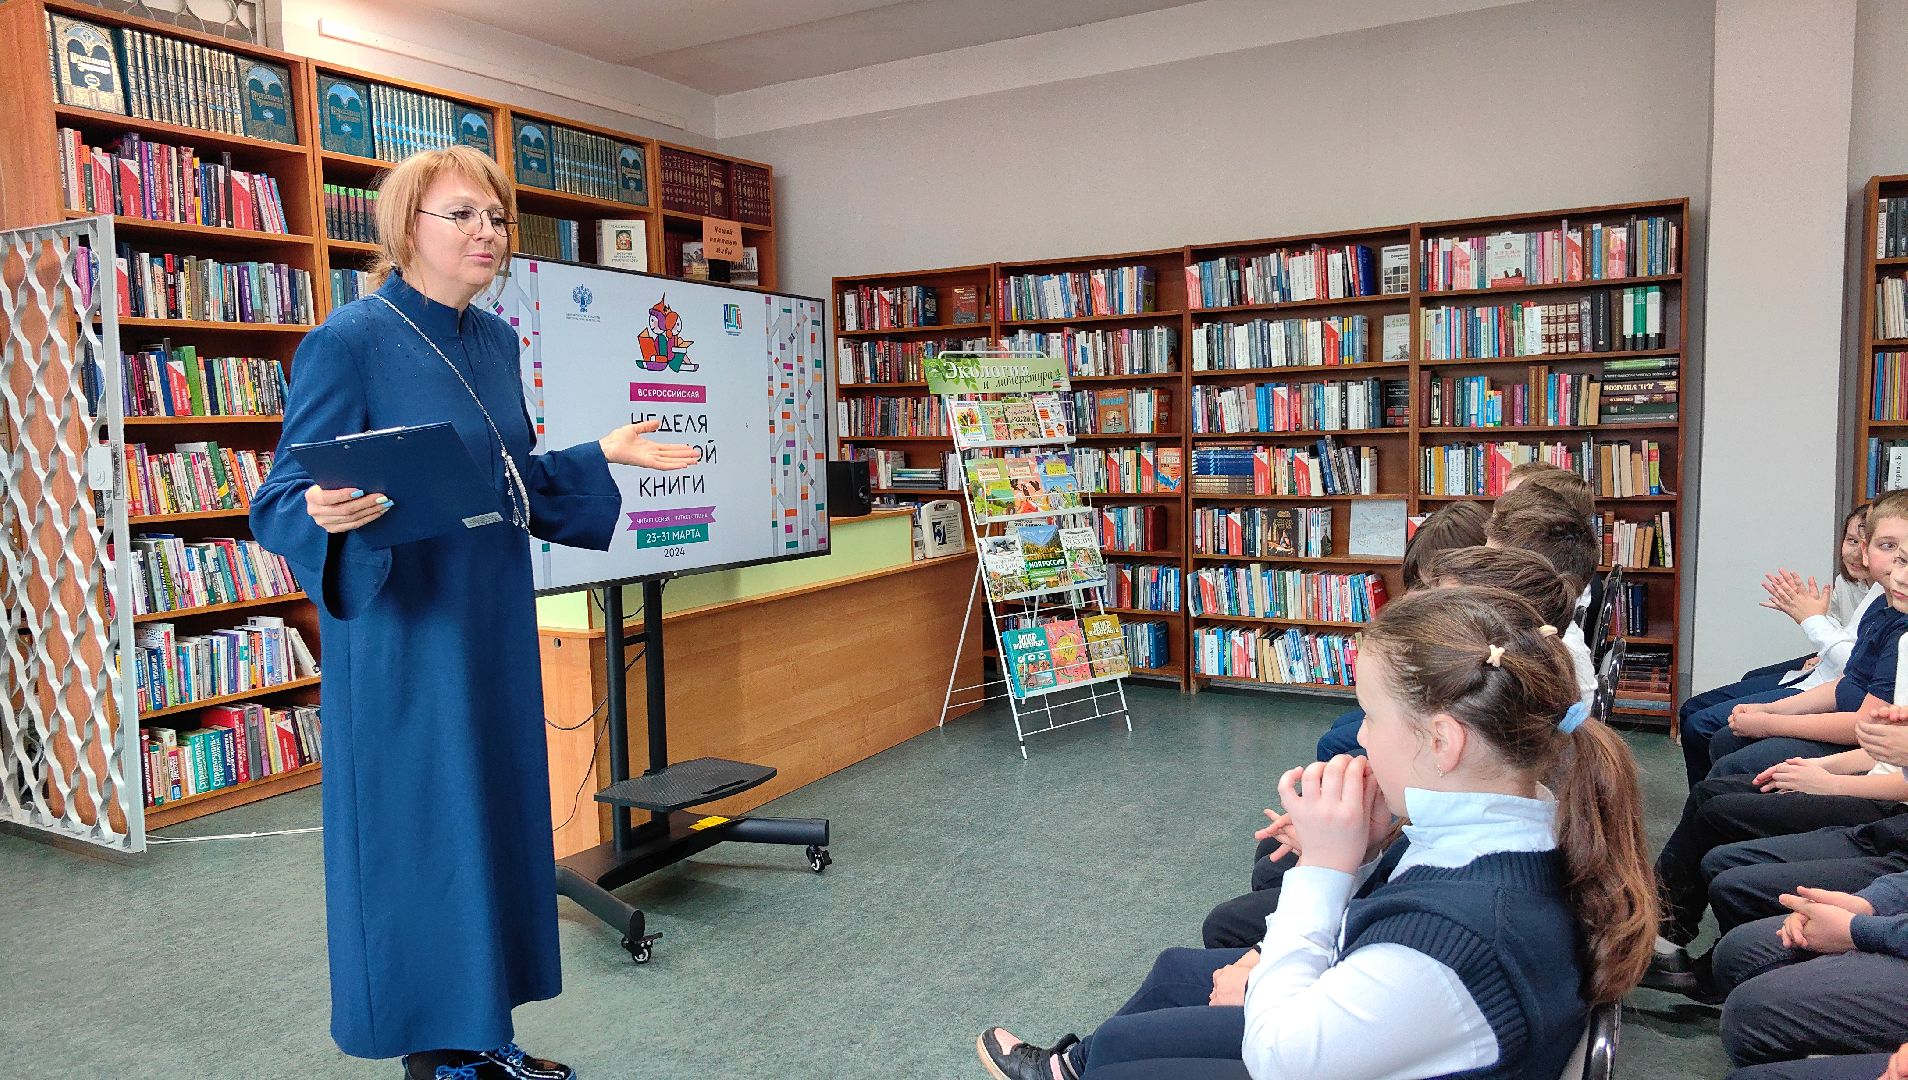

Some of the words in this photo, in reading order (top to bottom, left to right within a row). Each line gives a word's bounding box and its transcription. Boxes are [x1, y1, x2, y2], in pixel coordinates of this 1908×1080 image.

[943, 361, 1030, 380] Экология
[983, 380, 989, 390] и
[995, 370, 1054, 390] литература
[1603, 383, 1637, 391] УШАКОВ
[637, 388, 700, 399] ВСЕРОССИЙСКАЯ
[631, 412, 708, 433] НЕДЕЛЯ
[639, 474, 705, 498] КНИГИ
[645, 531, 670, 544] 23-31
[671, 528, 701, 541] МАРТА
[663, 547, 686, 558] 2024
